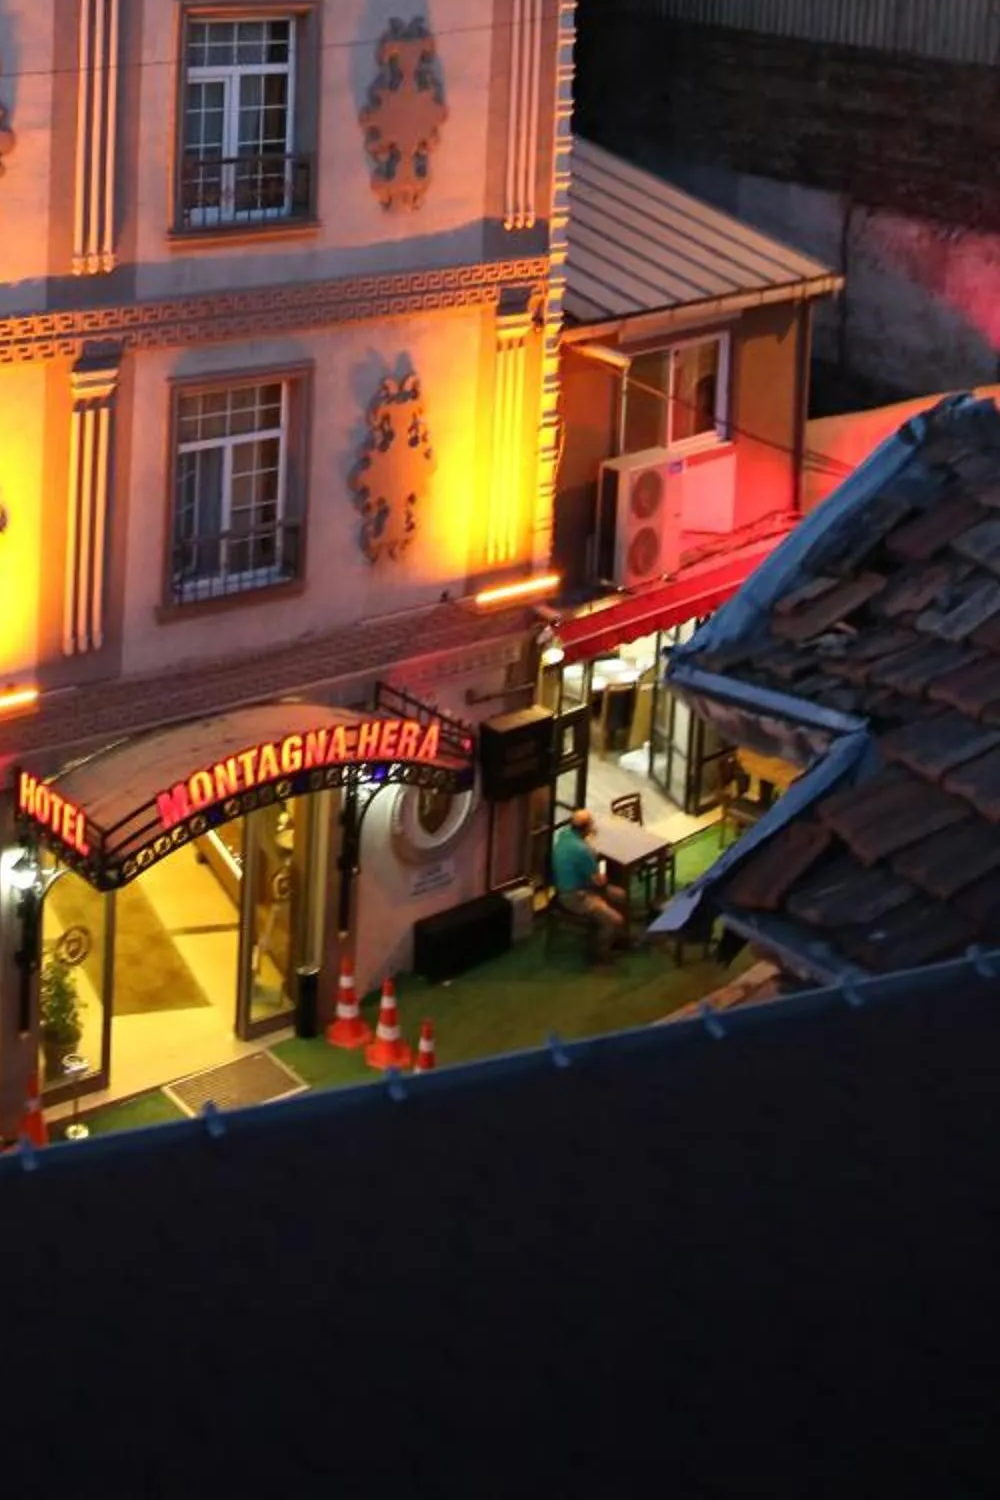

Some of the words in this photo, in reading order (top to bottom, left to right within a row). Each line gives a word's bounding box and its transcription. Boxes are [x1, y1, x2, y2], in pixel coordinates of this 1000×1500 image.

[19, 771, 90, 857] HOTEL
[156, 724, 347, 828] MONTAGNA
[356, 719, 441, 759] HERA
